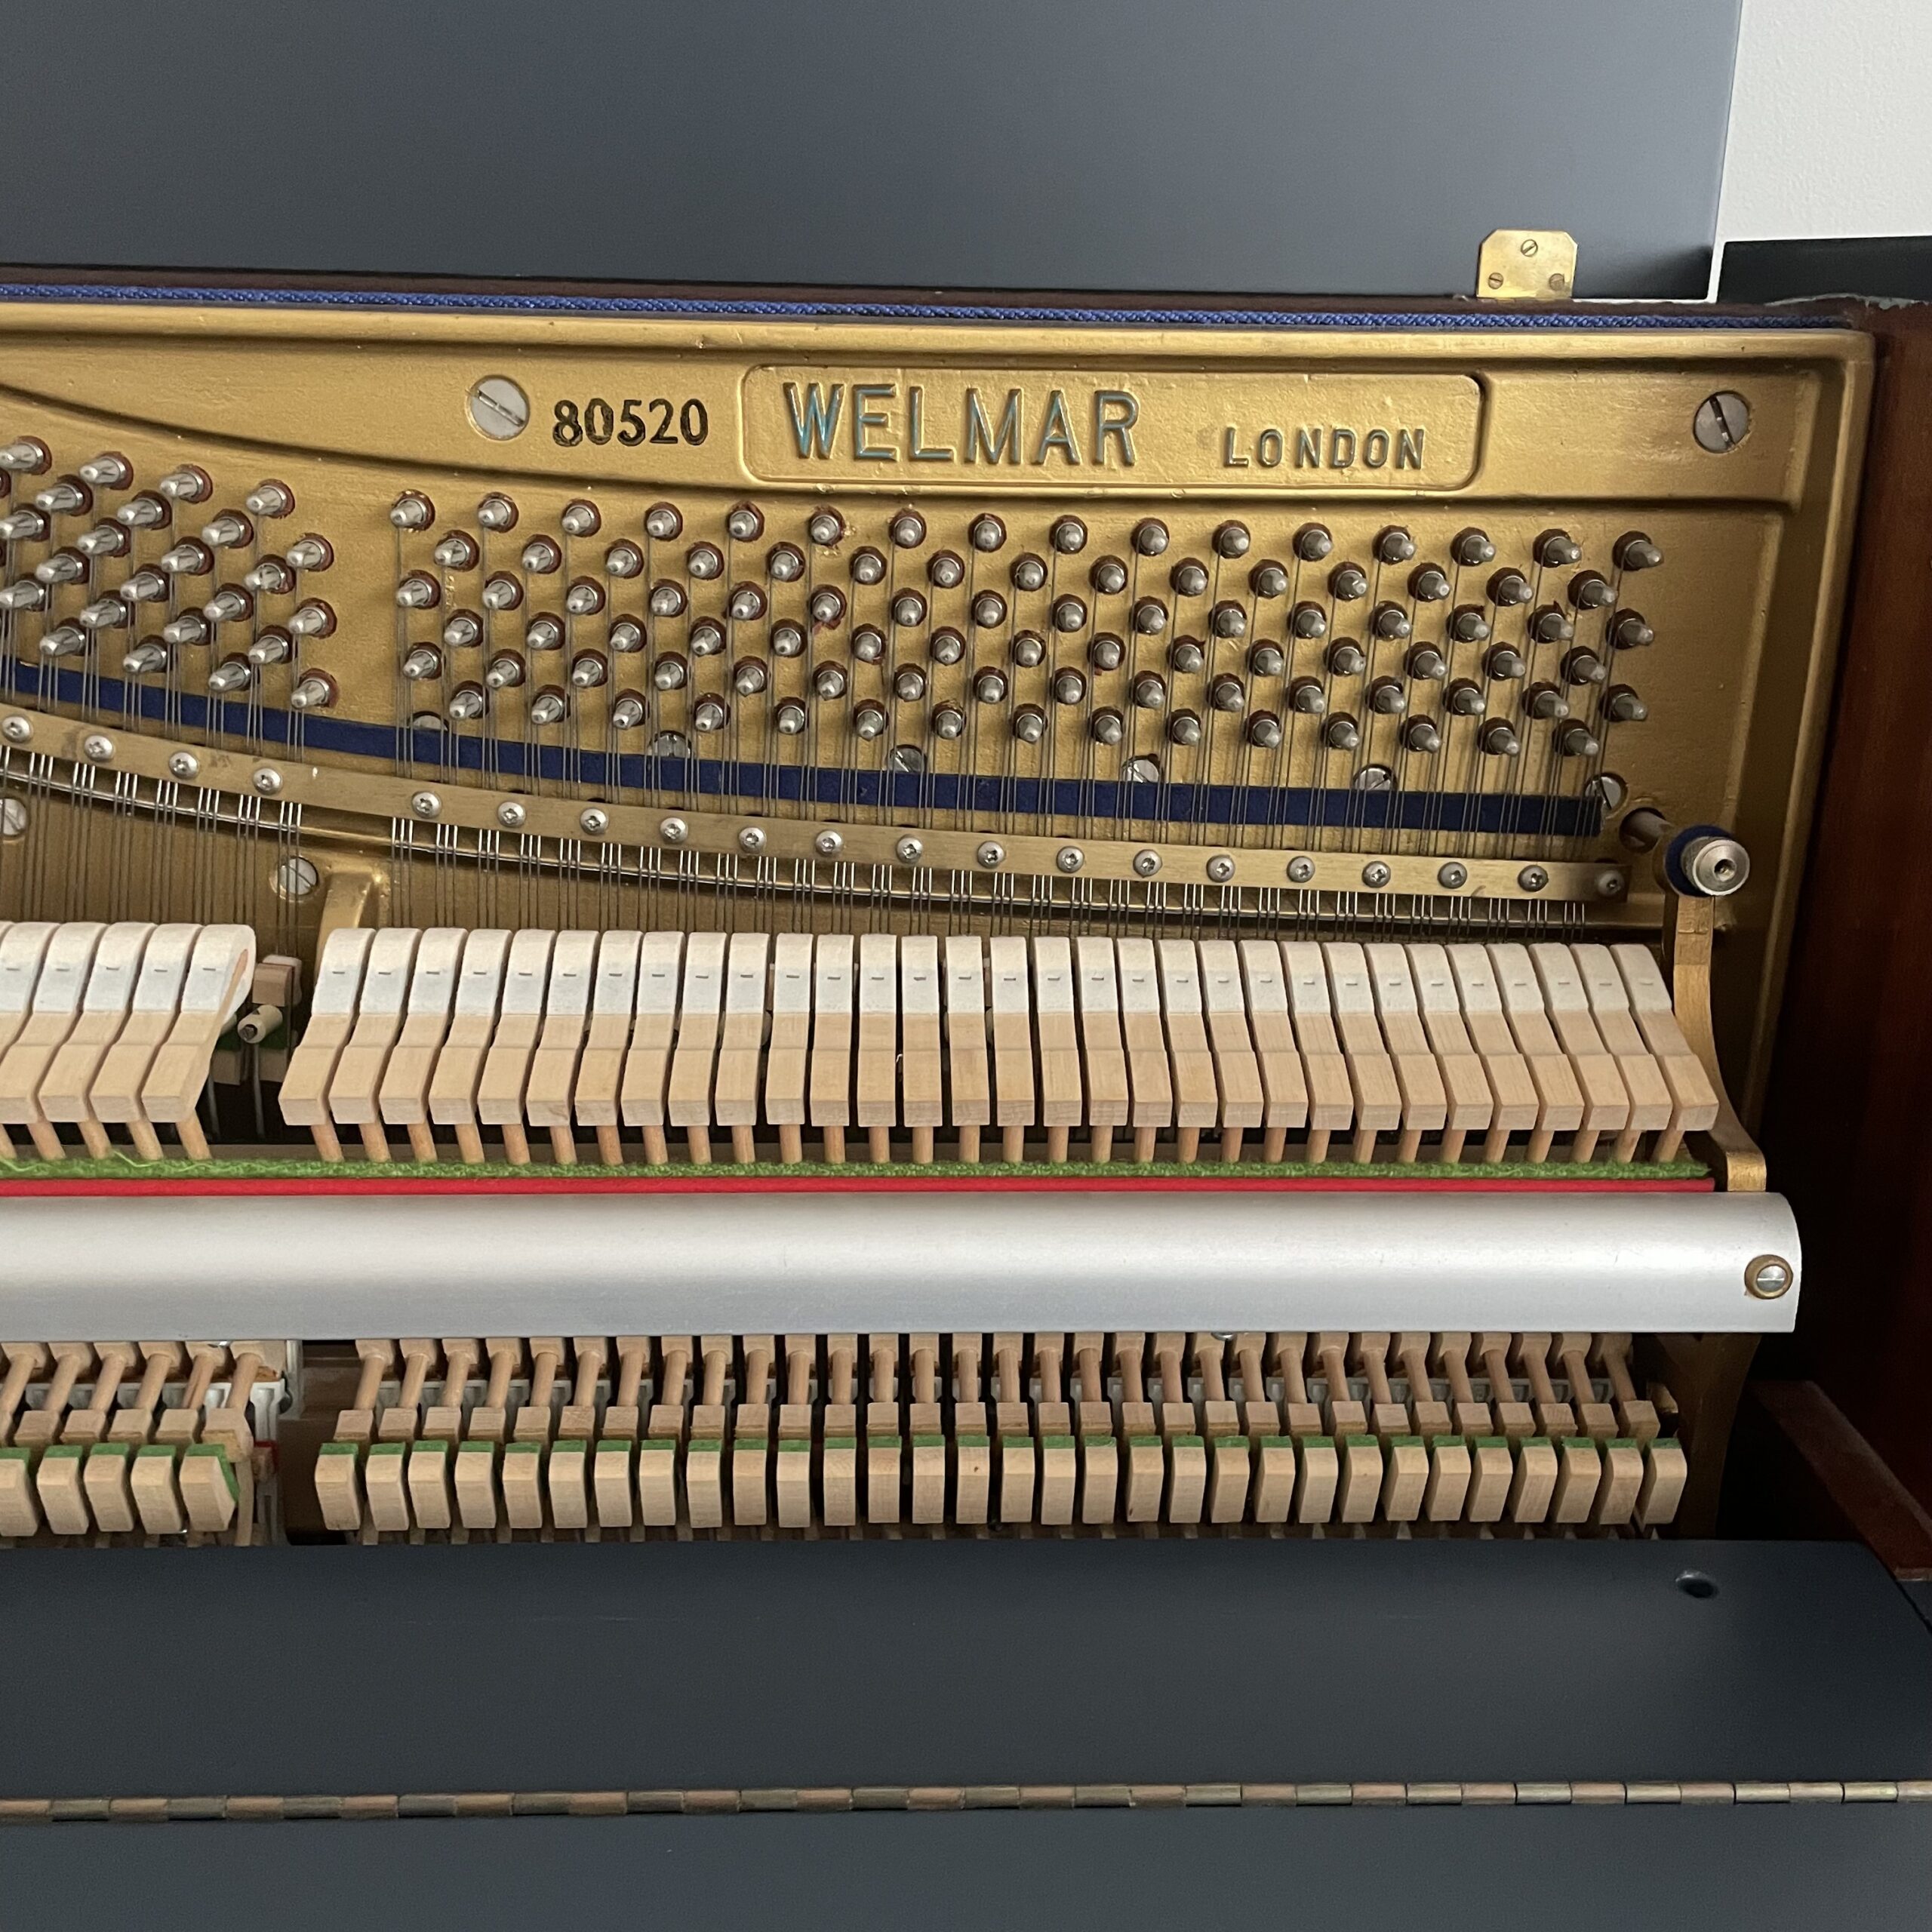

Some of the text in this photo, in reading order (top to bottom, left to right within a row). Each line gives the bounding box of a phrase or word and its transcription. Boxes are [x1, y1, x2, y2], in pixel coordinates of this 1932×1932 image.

[552, 398, 709, 448] 80520
[782, 381, 1426, 469] WELMAR LONDON
